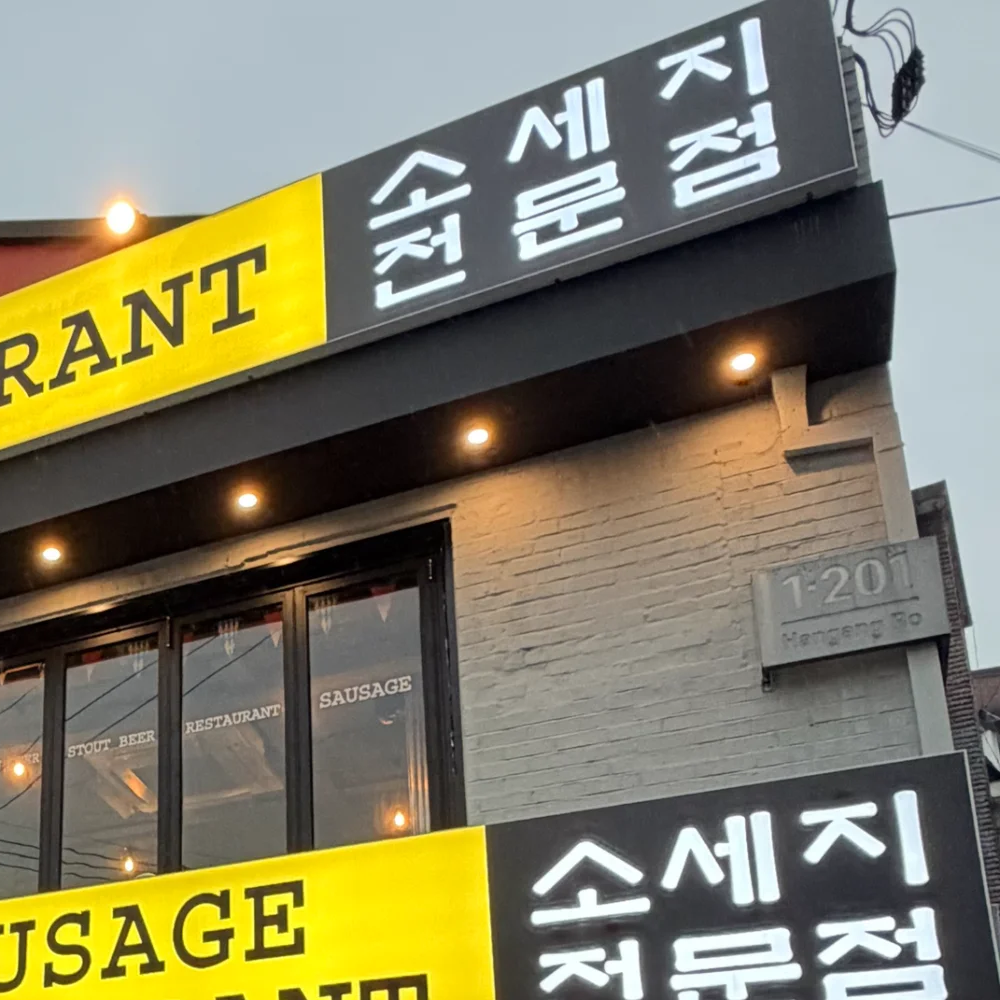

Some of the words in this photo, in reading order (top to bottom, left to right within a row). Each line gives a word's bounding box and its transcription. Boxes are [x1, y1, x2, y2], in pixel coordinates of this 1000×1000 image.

[368, 17, 771, 229] 소세지
[374, 102, 781, 309] 전문점
[318, 675, 412, 709] SAUSAGE
[184, 703, 281, 734] RESTAURANT
[67, 738, 111, 759] STOUT
[119, 729, 156, 747] BEER
[3, 752, 40, 776] ER
[530, 789, 930, 926] 소세지
